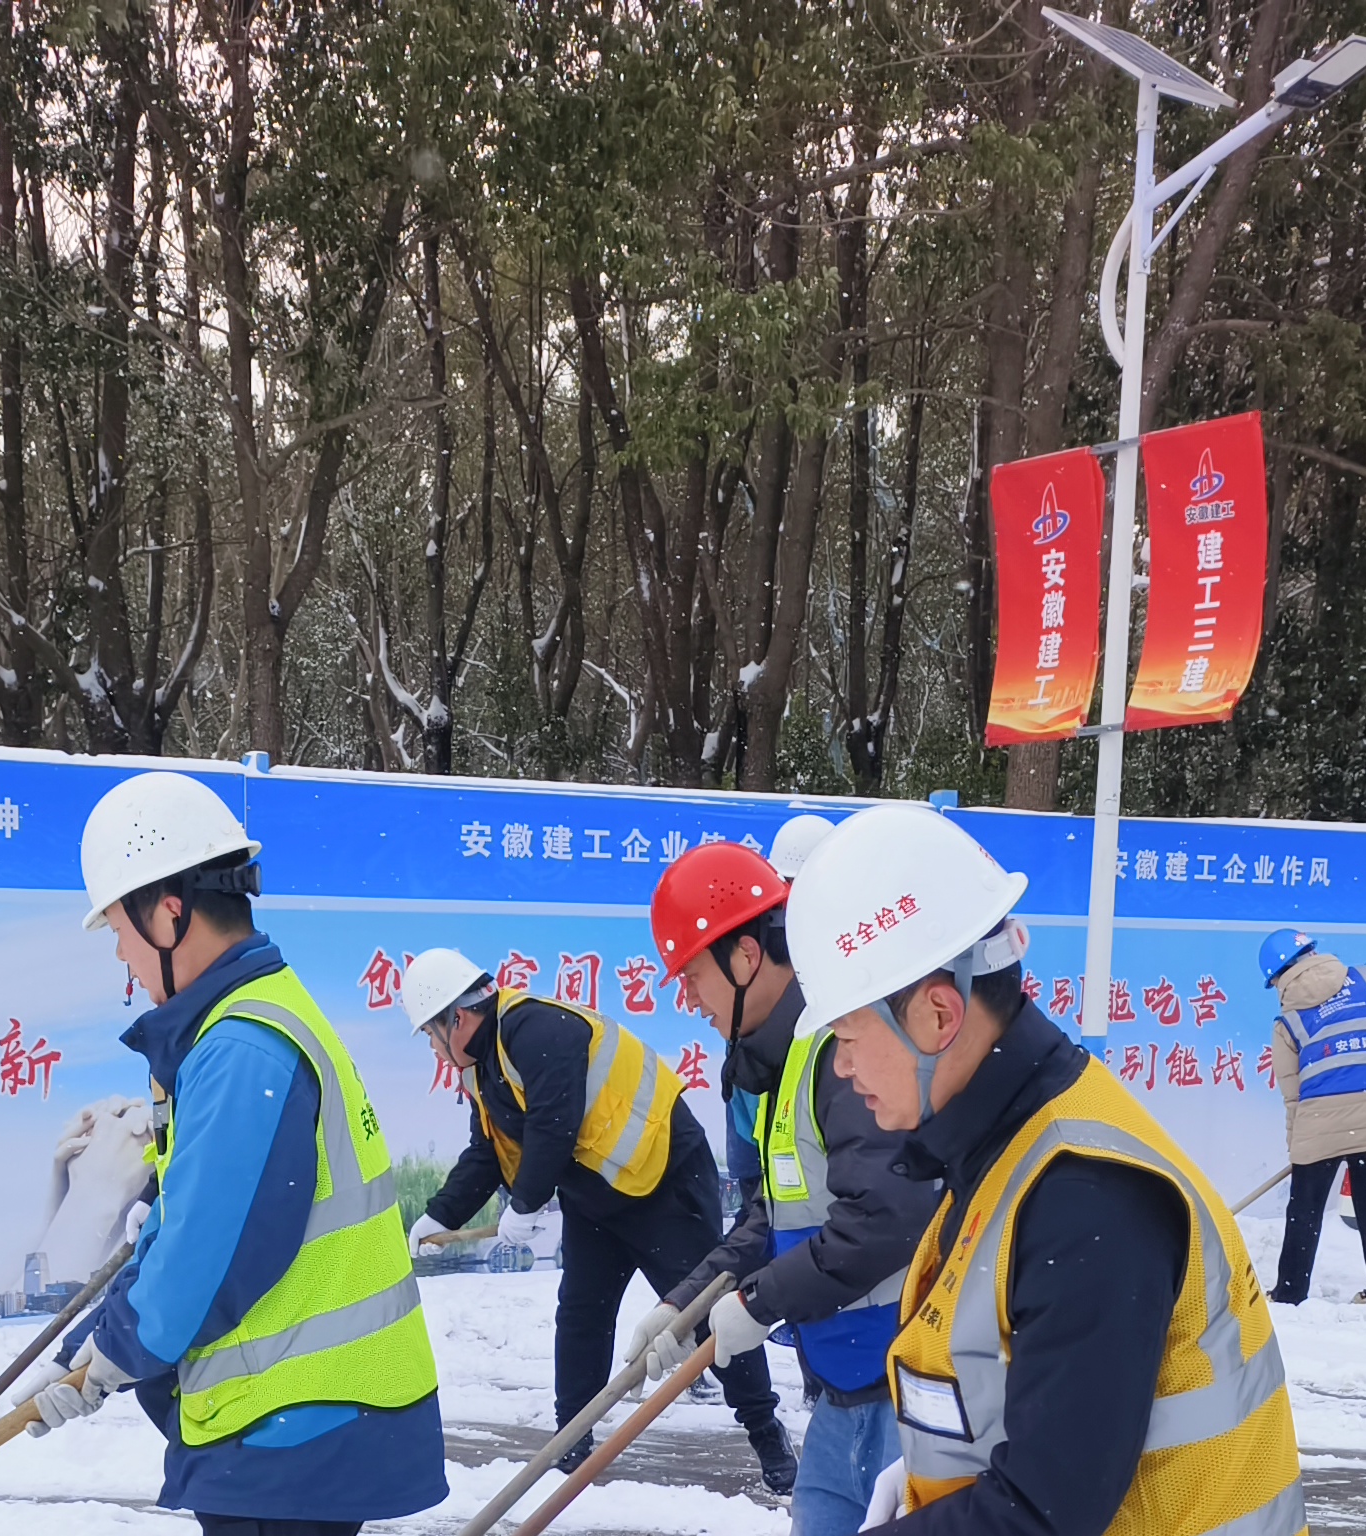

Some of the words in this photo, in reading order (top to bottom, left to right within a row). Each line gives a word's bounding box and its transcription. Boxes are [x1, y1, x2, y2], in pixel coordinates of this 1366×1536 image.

[1185, 501, 1235, 524] 安徽建工
[1028, 548, 1067, 706] 安徽建工
[1178, 529, 1224, 693] 建工三建
[835, 893, 922, 958] 安全检查
